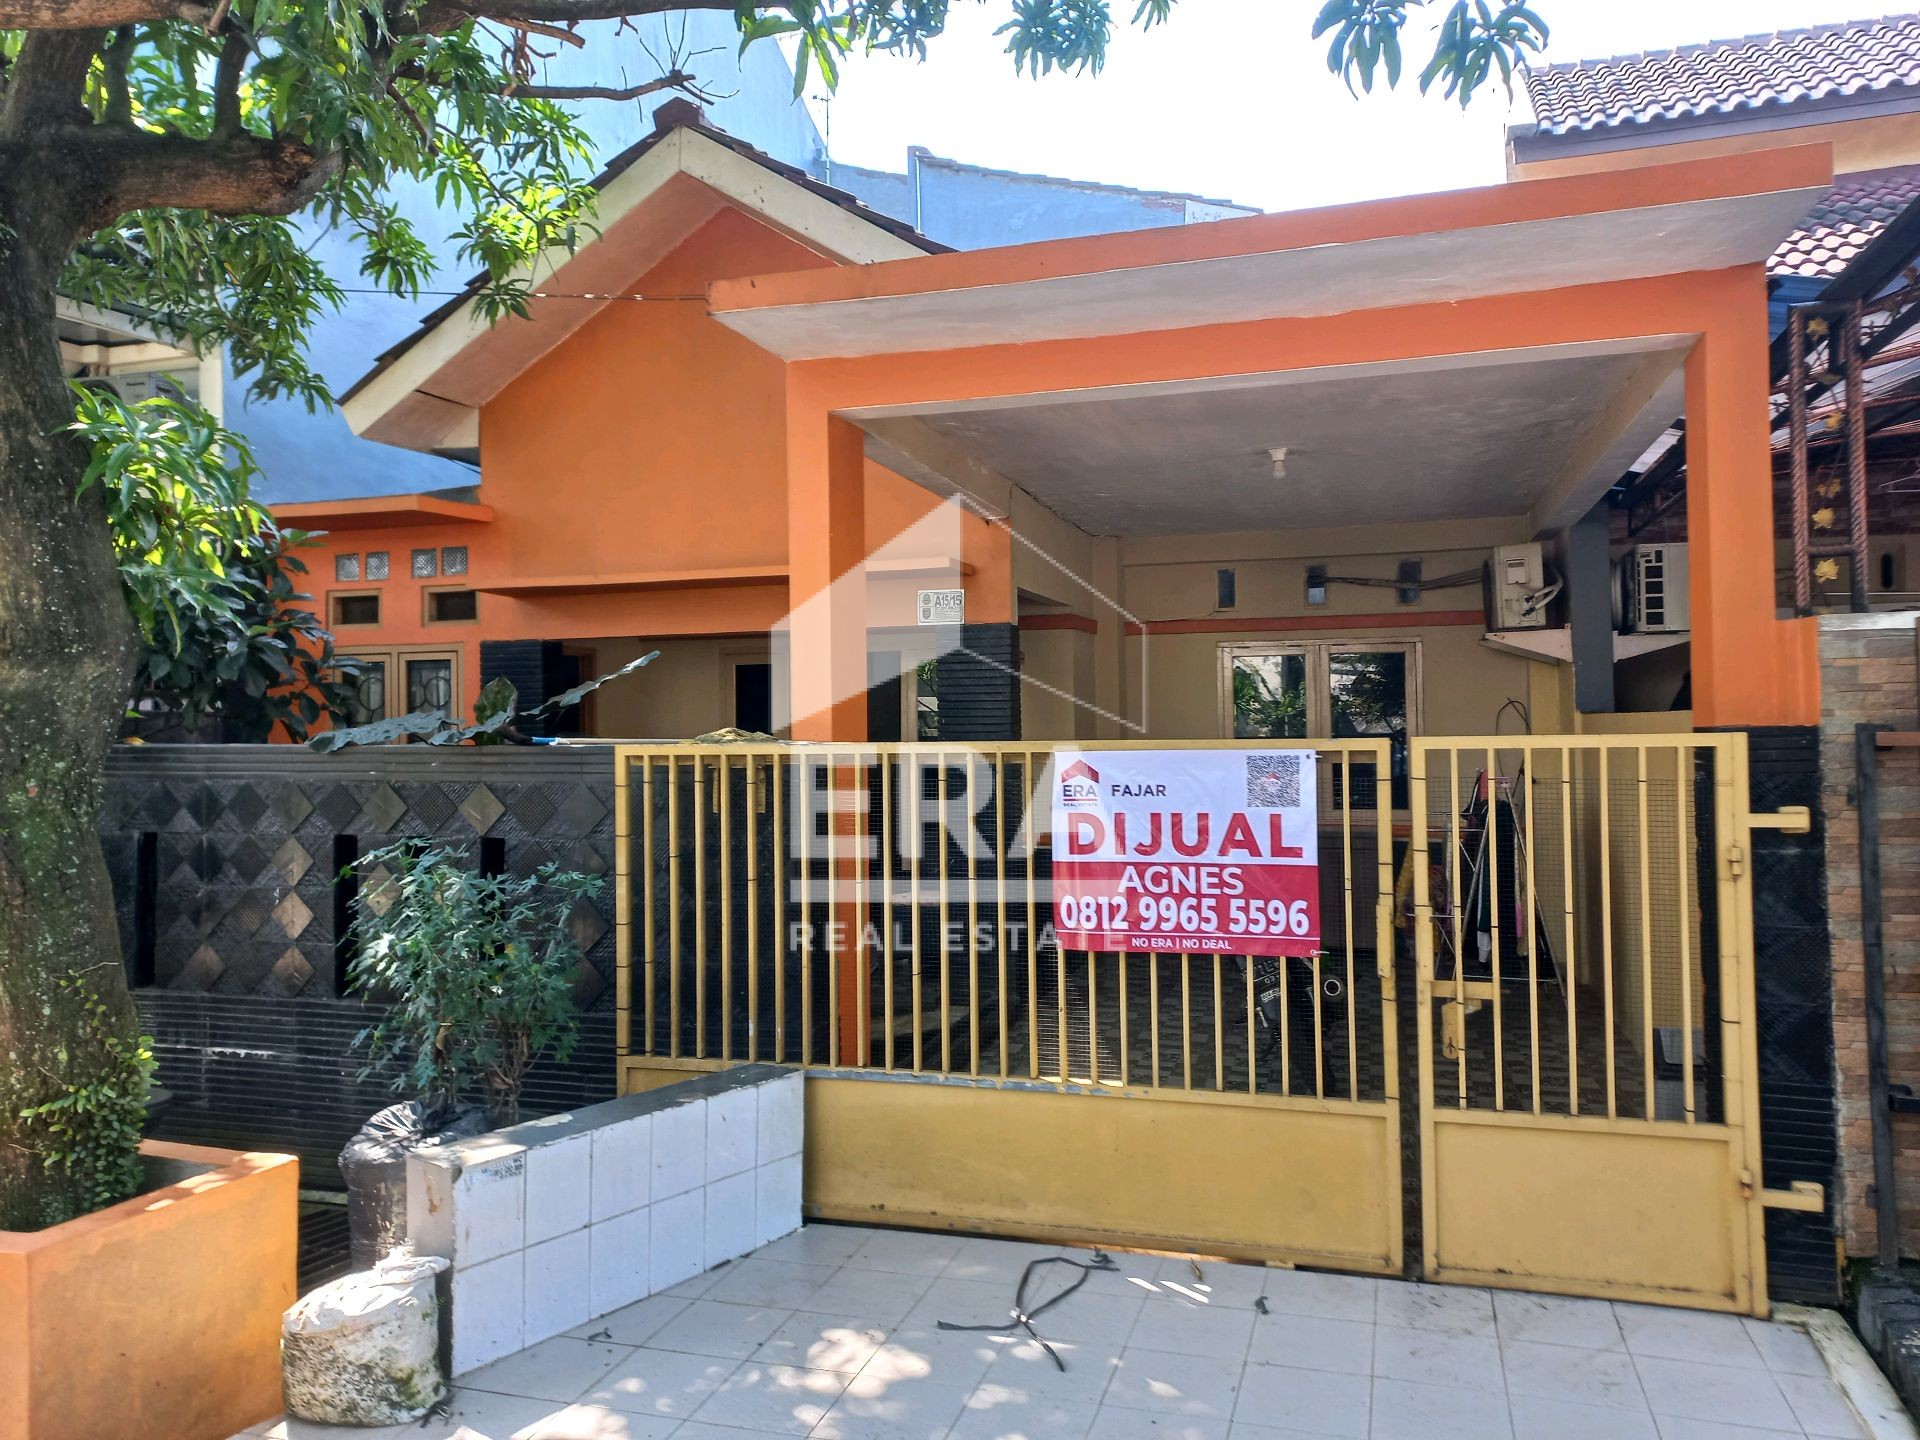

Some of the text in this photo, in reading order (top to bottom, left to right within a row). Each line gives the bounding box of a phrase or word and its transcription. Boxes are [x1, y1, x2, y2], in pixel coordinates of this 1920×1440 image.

[935, 595, 962, 607] A15/15
[1062, 784, 1167, 798] ERA FAJAR
[1067, 812, 1304, 859] DIJUAL
[1117, 865, 1245, 895] AGNES
[1060, 895, 1310, 936] 0812 9965 5596
[1131, 937, 1149, 948] NO
[1151, 938, 1174, 949] ERA
[1182, 938, 1200, 950] NO
[1201, 939, 1232, 951] DEAL
